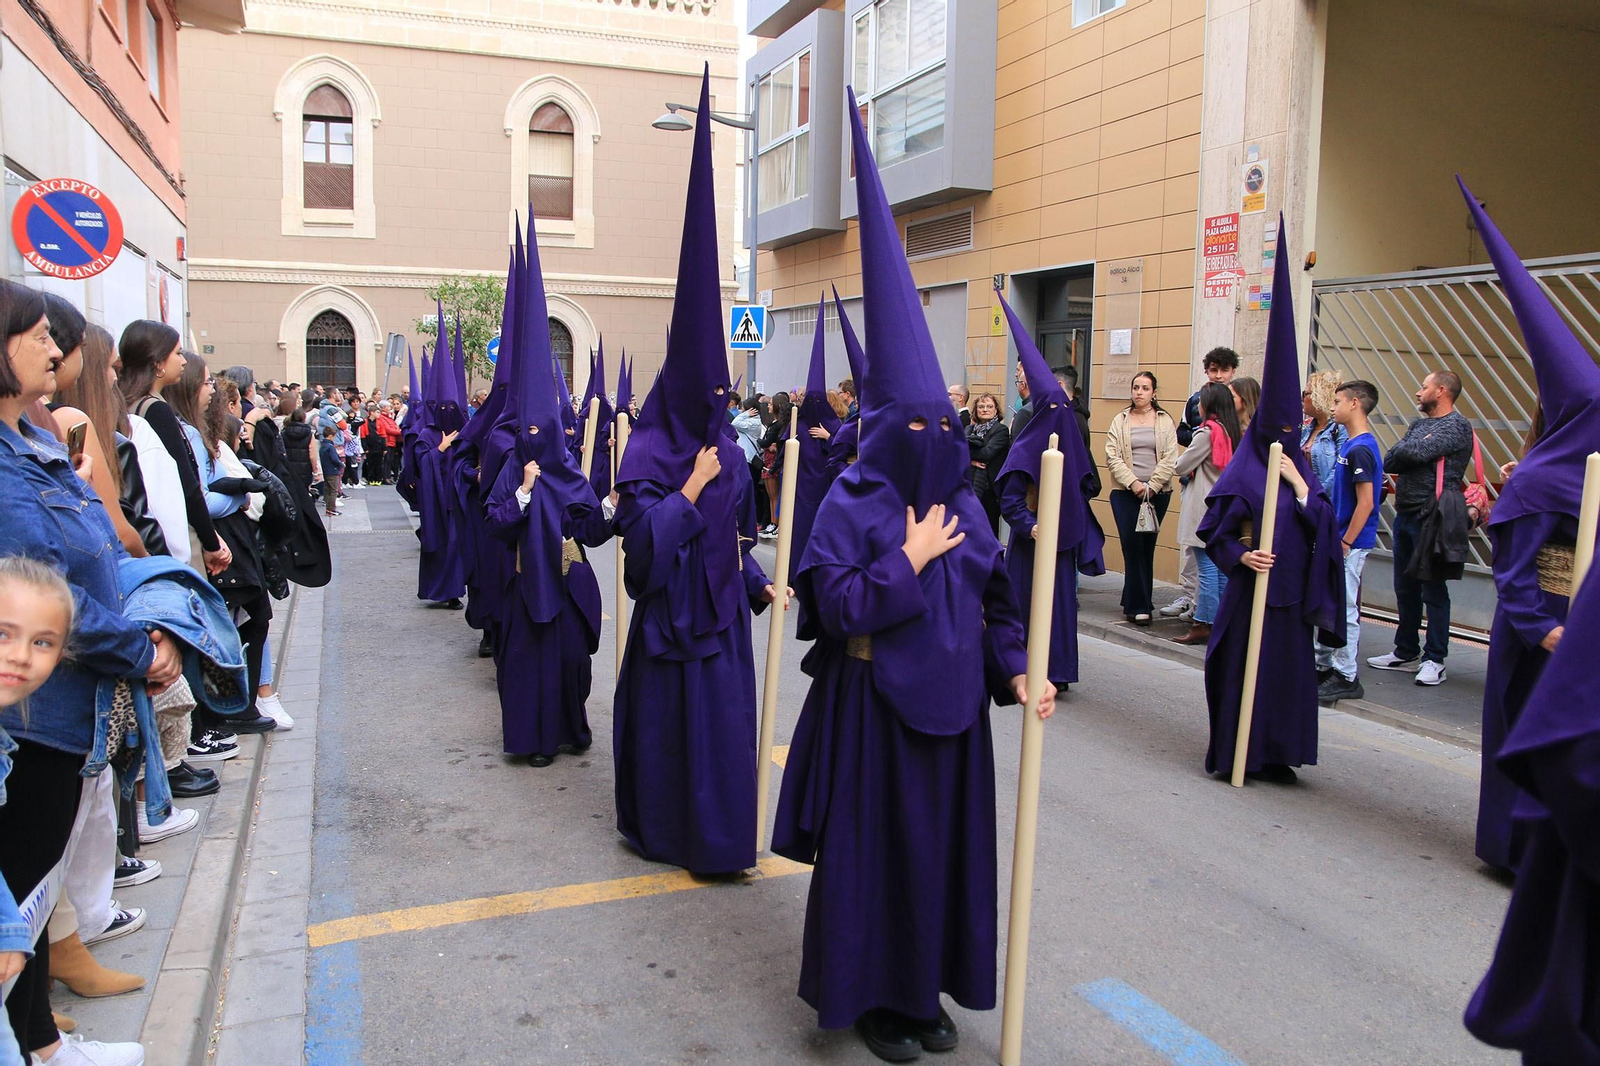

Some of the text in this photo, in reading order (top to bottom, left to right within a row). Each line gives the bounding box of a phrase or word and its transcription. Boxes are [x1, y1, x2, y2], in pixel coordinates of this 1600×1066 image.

[31, 180, 101, 200] EXCEPTO
[1205, 223, 1238, 237] PLAZA GARAJE
[1211, 216, 1232, 227] SE ALQUILA
[24, 250, 114, 278] AMBULANCIA
